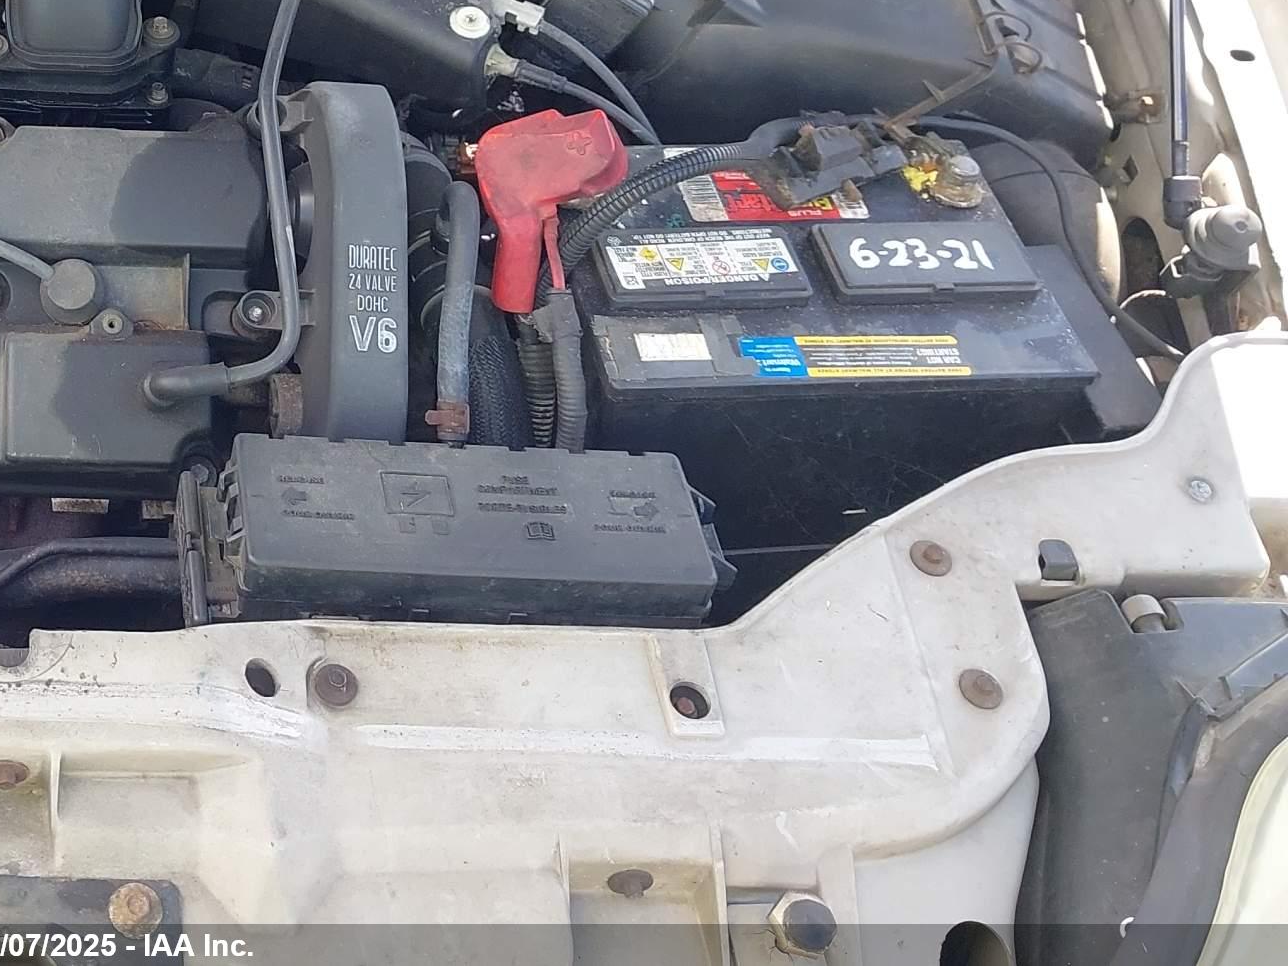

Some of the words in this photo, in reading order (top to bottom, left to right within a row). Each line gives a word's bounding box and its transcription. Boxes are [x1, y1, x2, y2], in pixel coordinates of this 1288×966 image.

[348, 245, 397, 271] DURATEC
[849, 237, 995, 270] 6-23-21
[349, 273, 361, 290] 24
[365, 275, 397, 292] VALVE
[357, 294, 389, 313] DOHC
[349, 315, 397, 353] V6
